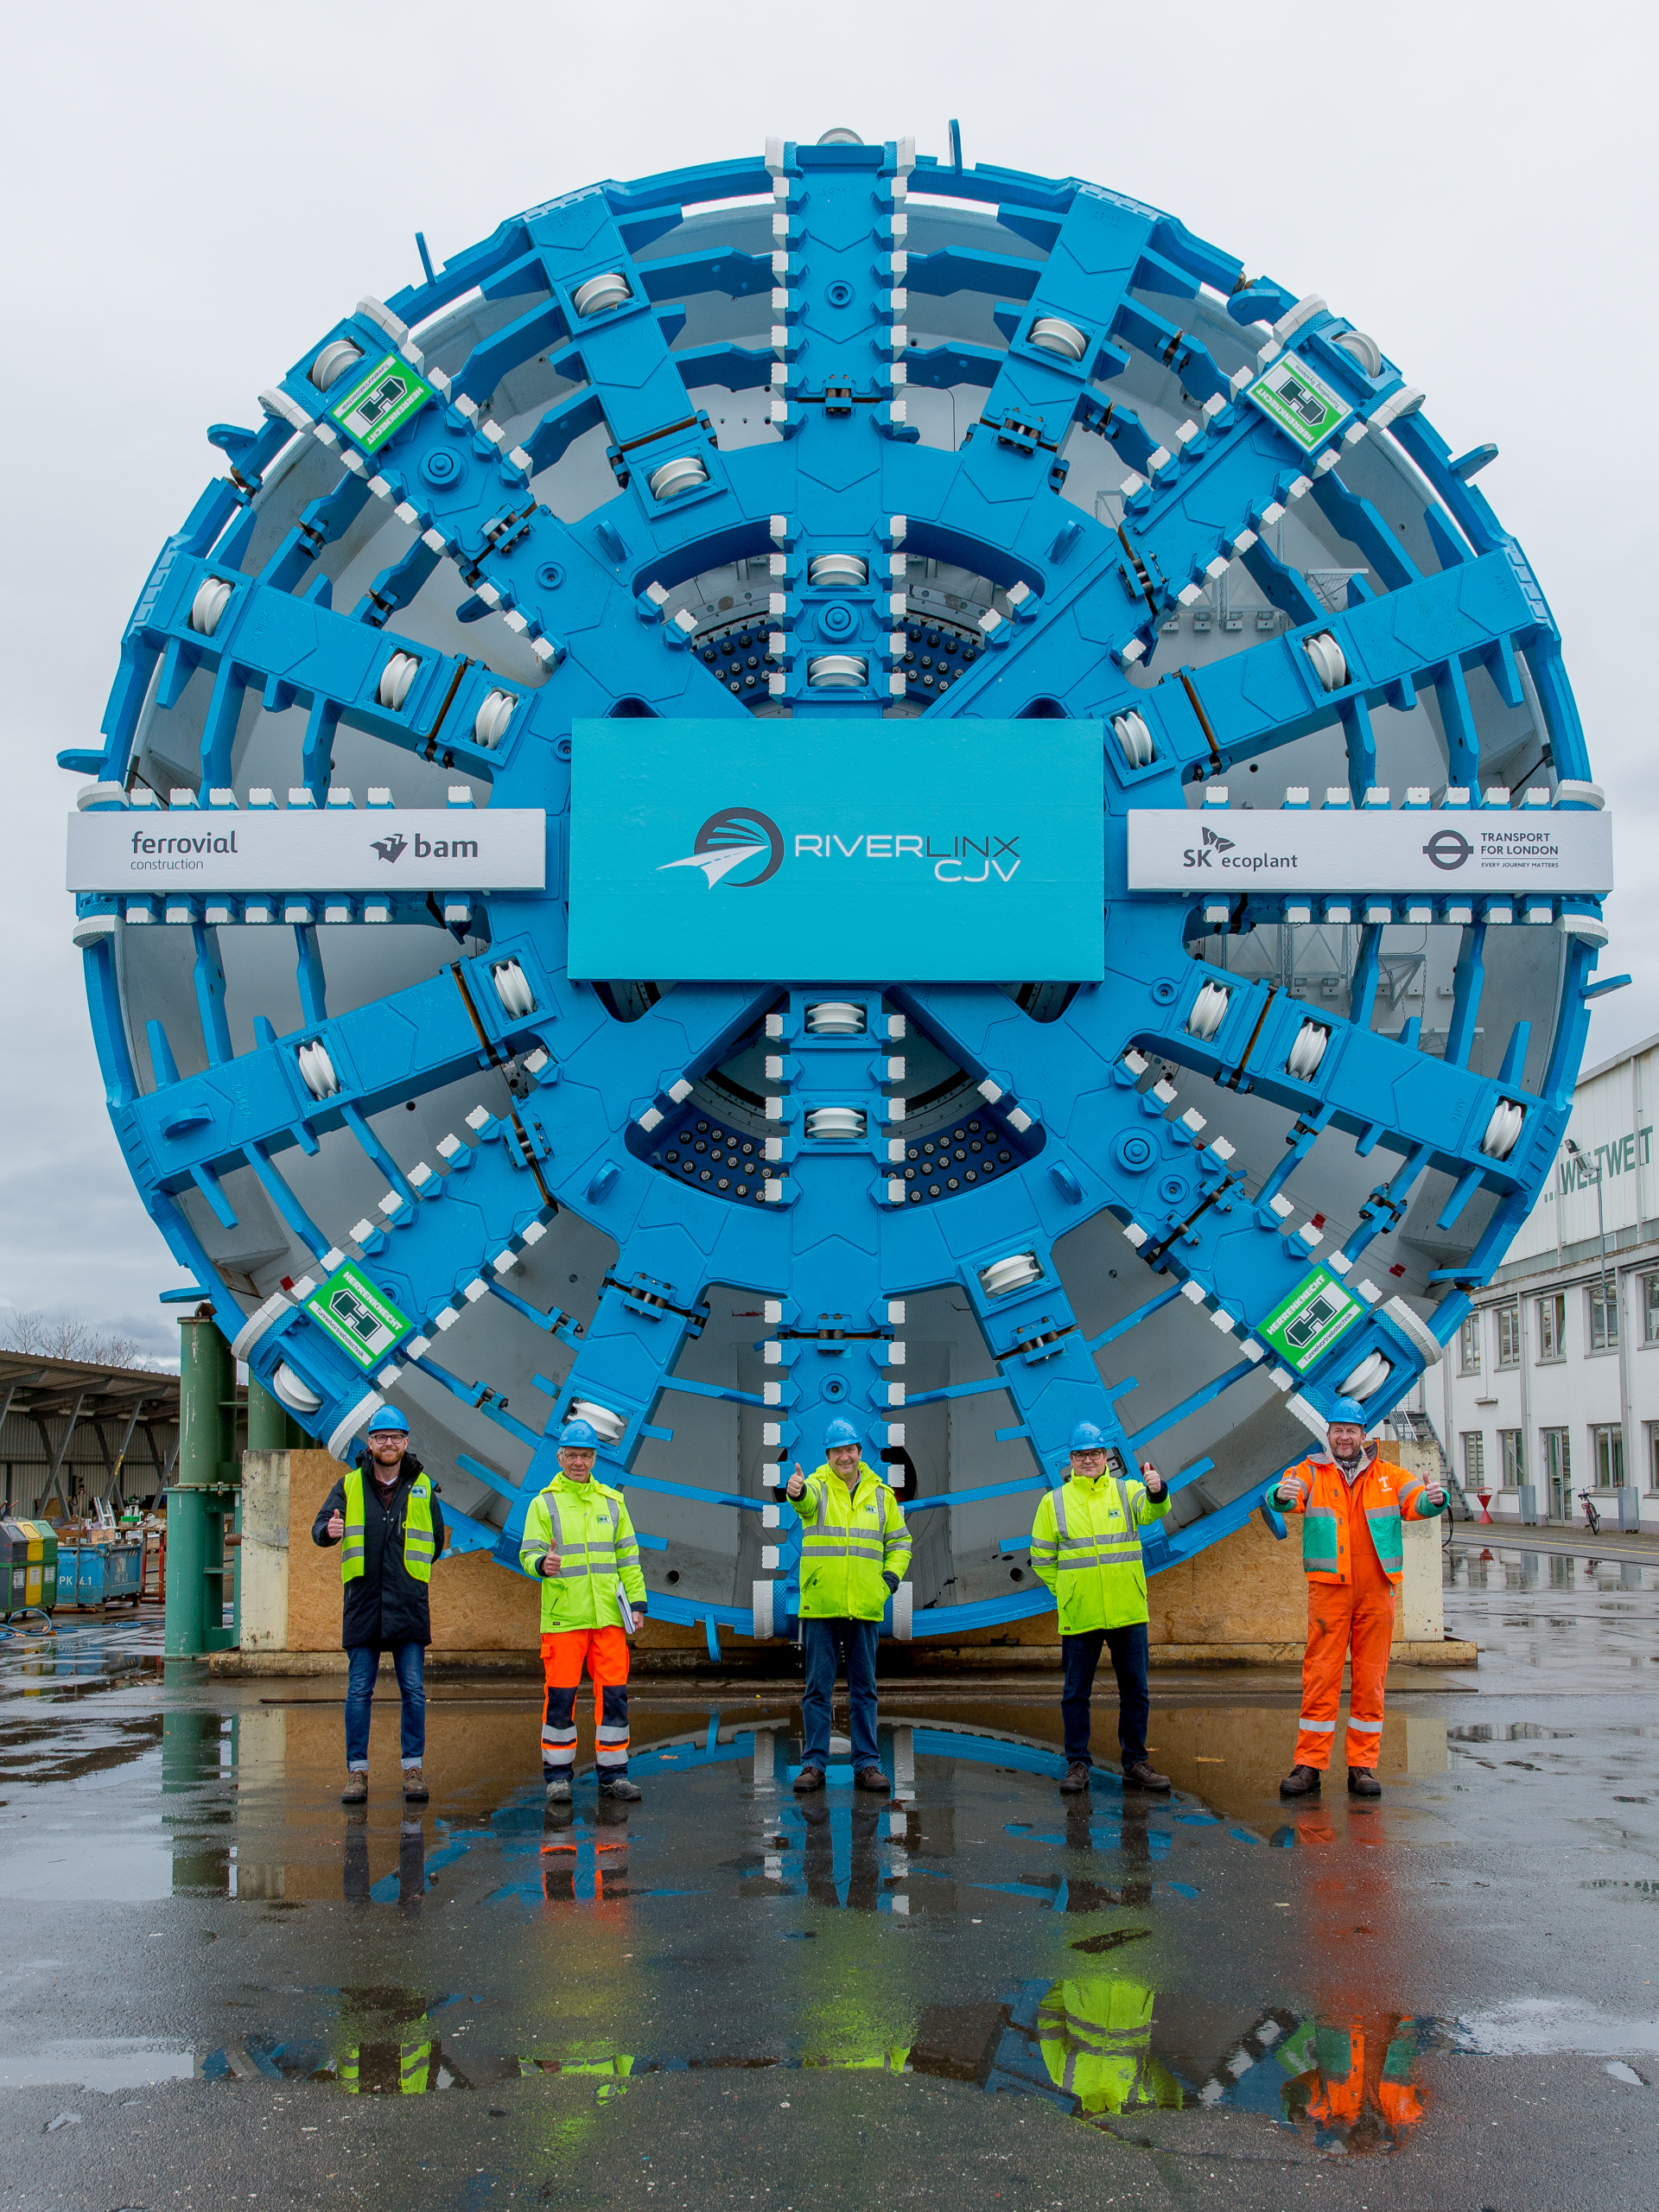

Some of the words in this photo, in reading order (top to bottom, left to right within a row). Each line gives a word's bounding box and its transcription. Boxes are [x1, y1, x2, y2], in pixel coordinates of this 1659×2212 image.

[341, 363, 390, 410] Tunnelvortriebstechnik
[1294, 365, 1315, 386] Systems
[1315, 383, 1340, 410] Tunnelling
[366, 386, 424, 445] HERRENKNECHT
[1255, 387, 1314, 443] HERRENKNECHT
[131, 830, 238, 854] ferrovial
[414, 833, 479, 858] bam
[795, 835, 1020, 858] RIVERLINX
[1480, 832, 1550, 842] TRANSPORT
[1183, 849, 1212, 868] SK
[1221, 852, 1298, 873] ecoplant
[1480, 846, 1504, 855] FOR
[1507, 846, 1559, 855] LONDON
[130, 859, 204, 870] construction
[934, 860, 1020, 882] CJV
[342, 1270, 403, 1331] HERRENKNECHT
[1266, 1274, 1325, 1335] HERRENKNECHT
[315, 1306, 365, 1357] Tunnelvortriebstechnik
[1303, 1313, 1353, 1362] Tunnelvortriebstechnik
[59, 1575, 73, 1586] PK
[79, 1576, 92, 1586] 4.1
